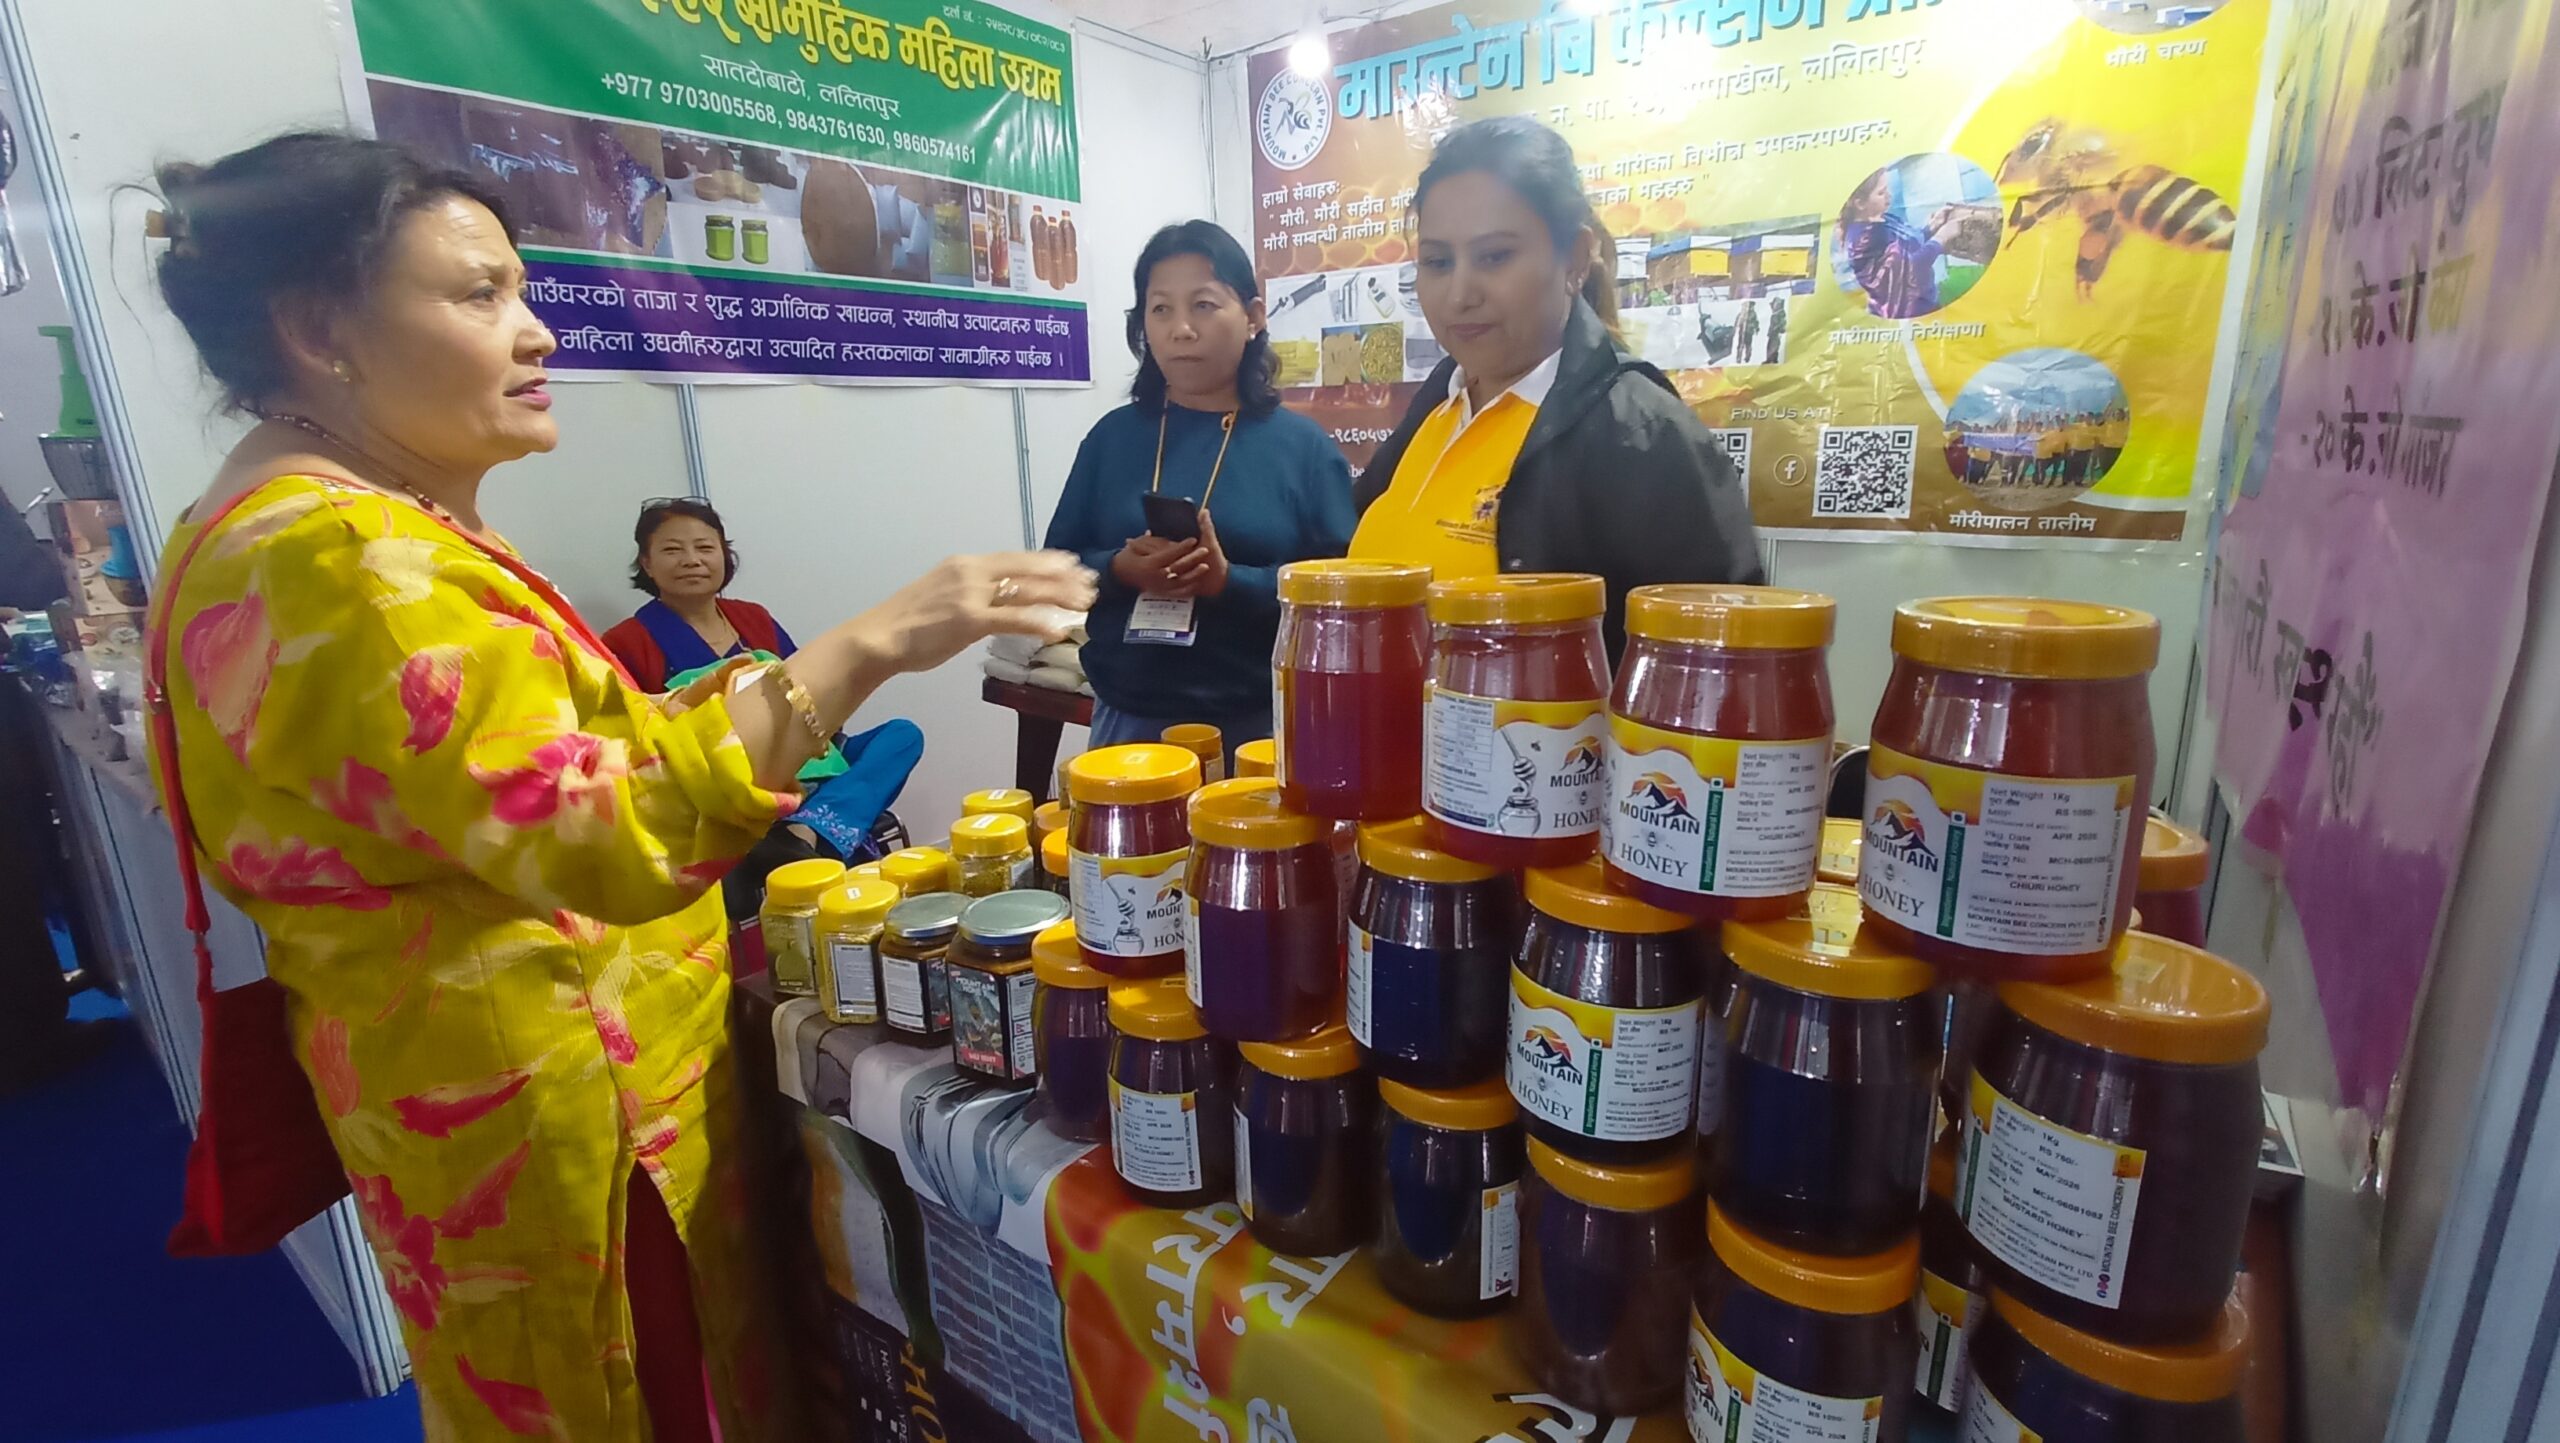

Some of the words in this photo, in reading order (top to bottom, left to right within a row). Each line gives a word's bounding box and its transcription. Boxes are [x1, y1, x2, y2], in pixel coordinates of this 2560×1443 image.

[895, 16, 996, 90] महिला
[998, 50, 1063, 107] उद्यम
[1333, 13, 1530, 120] माउन्टेन
[1800, 37, 1927, 84] ललितपुर
[700, 54, 812, 101] सातदोबाटो,
[817, 83, 902, 121] ललितपुर
[1268, 80, 1284, 102] BEE
[1285, 74, 1325, 105] COCERN
[600, 71, 653, 100] +977
[660, 81, 784, 129] 9703005568,
[786, 108, 890, 150] 9843761630,
[893, 130, 976, 164] 9860574161
[1262, 103, 1287, 161] MOUNTAIN
[1262, 184, 1288, 210] हाम्रो
[1292, 180, 1341, 201] सेवाहरु:
[1346, 194, 1385, 218] सहीत
[1292, 225, 1337, 248] सम्बन्धी
[1341, 218, 1385, 241] तालीम
[632, 288, 677, 312] ताजा
[682, 292, 699, 313] र
[705, 294, 743, 321] शुद्ध
[751, 293, 830, 321] अर्गानिक
[902, 308, 960, 331] स्थानीय
[963, 313, 1031, 335] उत्पादनहरु
[558, 325, 634, 353] महिला
[641, 330, 763, 359] उद्यमीहरुद्वारा
[769, 337, 836, 358] उत्पादित
[841, 341, 934, 364] हस्तकलाका
[939, 345, 1011, 367] सामाग्रीहरु
[1015, 344, 1052, 369] पाईन्छ
[1731, 406, 1769, 421] FIND
[1774, 405, 1798, 421] US
[1949, 509, 2032, 531] मौरीपालन
[2038, 511, 2098, 532] तालीम
[1619, 800, 1701, 836] MOUNTAIN
[1621, 843, 1689, 879] HONEY
[1865, 823, 1939, 874] MOUNTAIN
[1146, 904, 1185, 920] MOUN
[1863, 872, 1925, 919] HONEY
[1153, 931, 1185, 949] HON
[1516, 1042, 1583, 1086] MOUNTAIN
[1517, 1079, 1574, 1121] HONEY
[2035, 1166, 2057, 1180] MAY
[2002, 1194, 2046, 1225] MUSTARD
[2045, 1220, 2083, 1239] HONEY
[2107, 1218, 2119, 1236] BEE
[2099, 1234, 2116, 1273] MOUNTAIN
